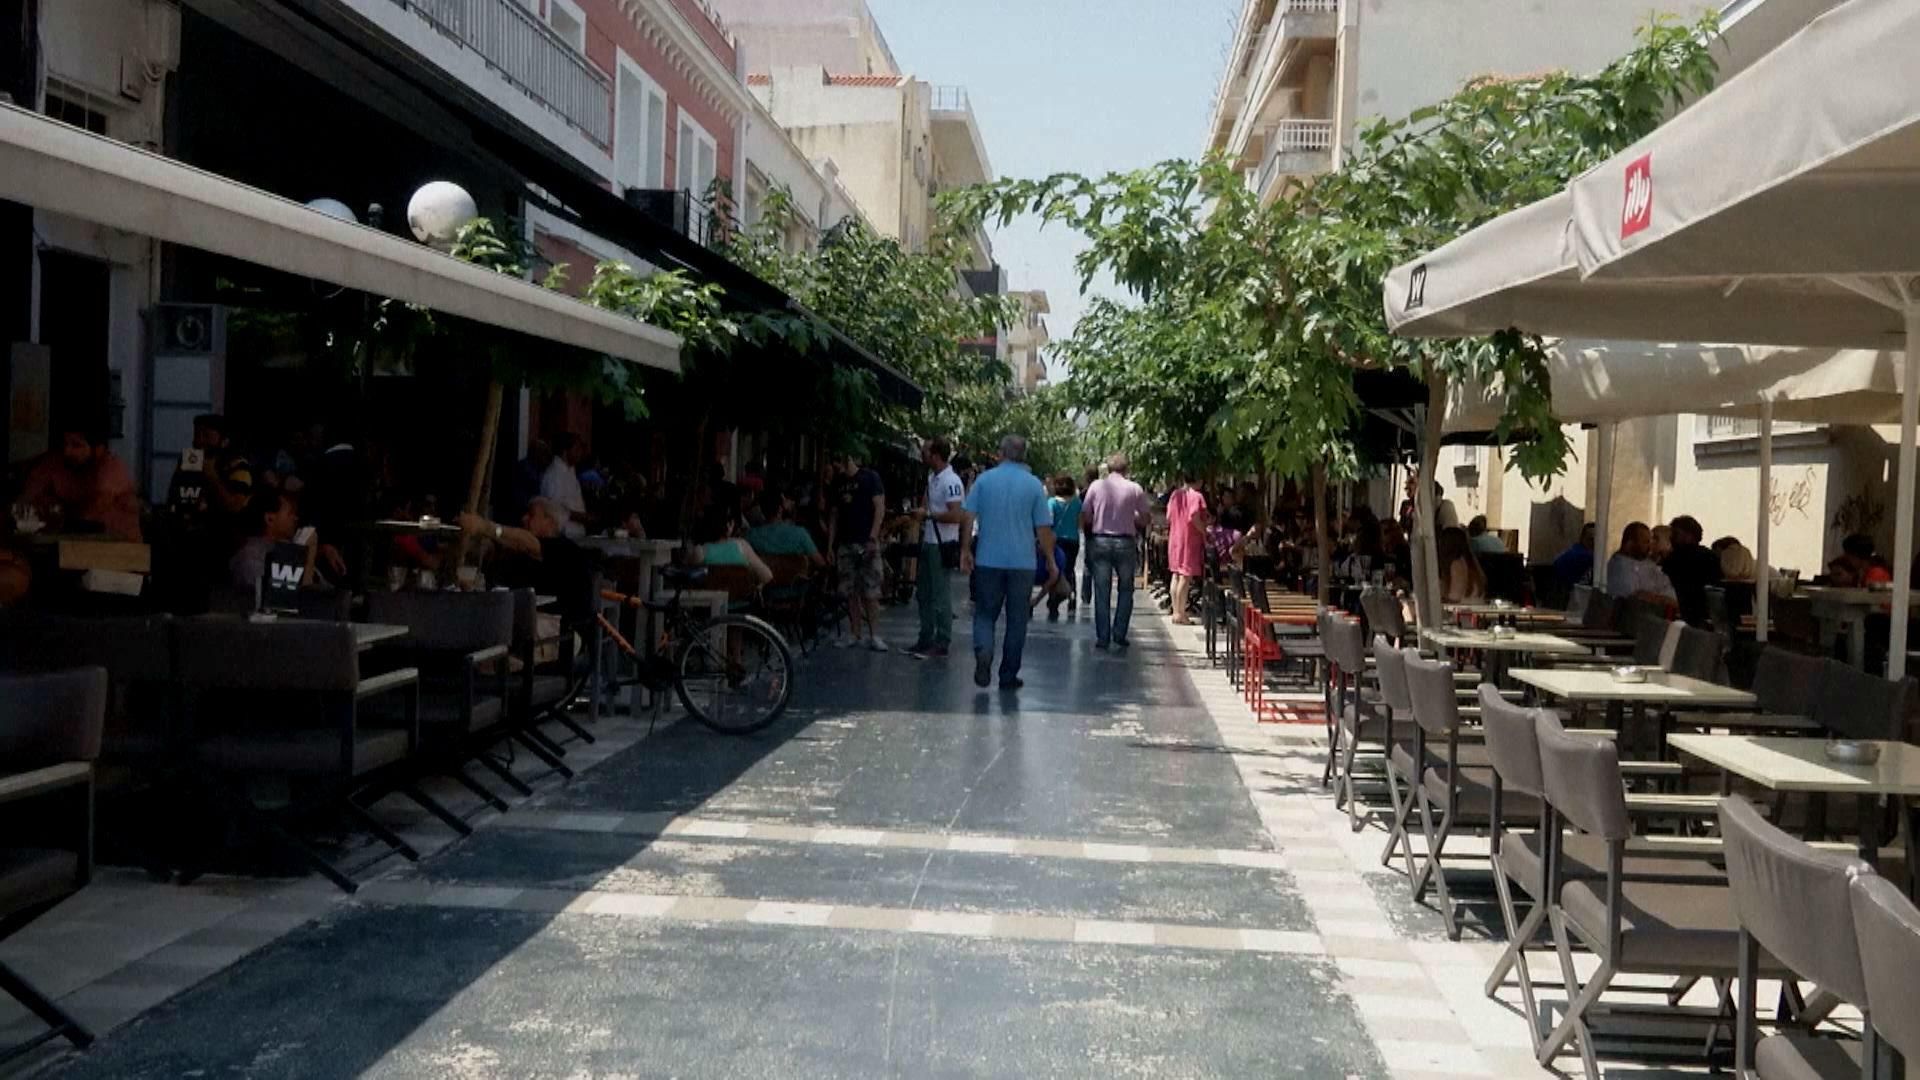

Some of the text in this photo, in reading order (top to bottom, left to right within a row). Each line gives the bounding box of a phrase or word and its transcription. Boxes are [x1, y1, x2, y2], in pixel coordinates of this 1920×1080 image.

[1624, 167, 1650, 224] illy
[949, 484, 961, 497] 10
[271, 562, 304, 583] W
